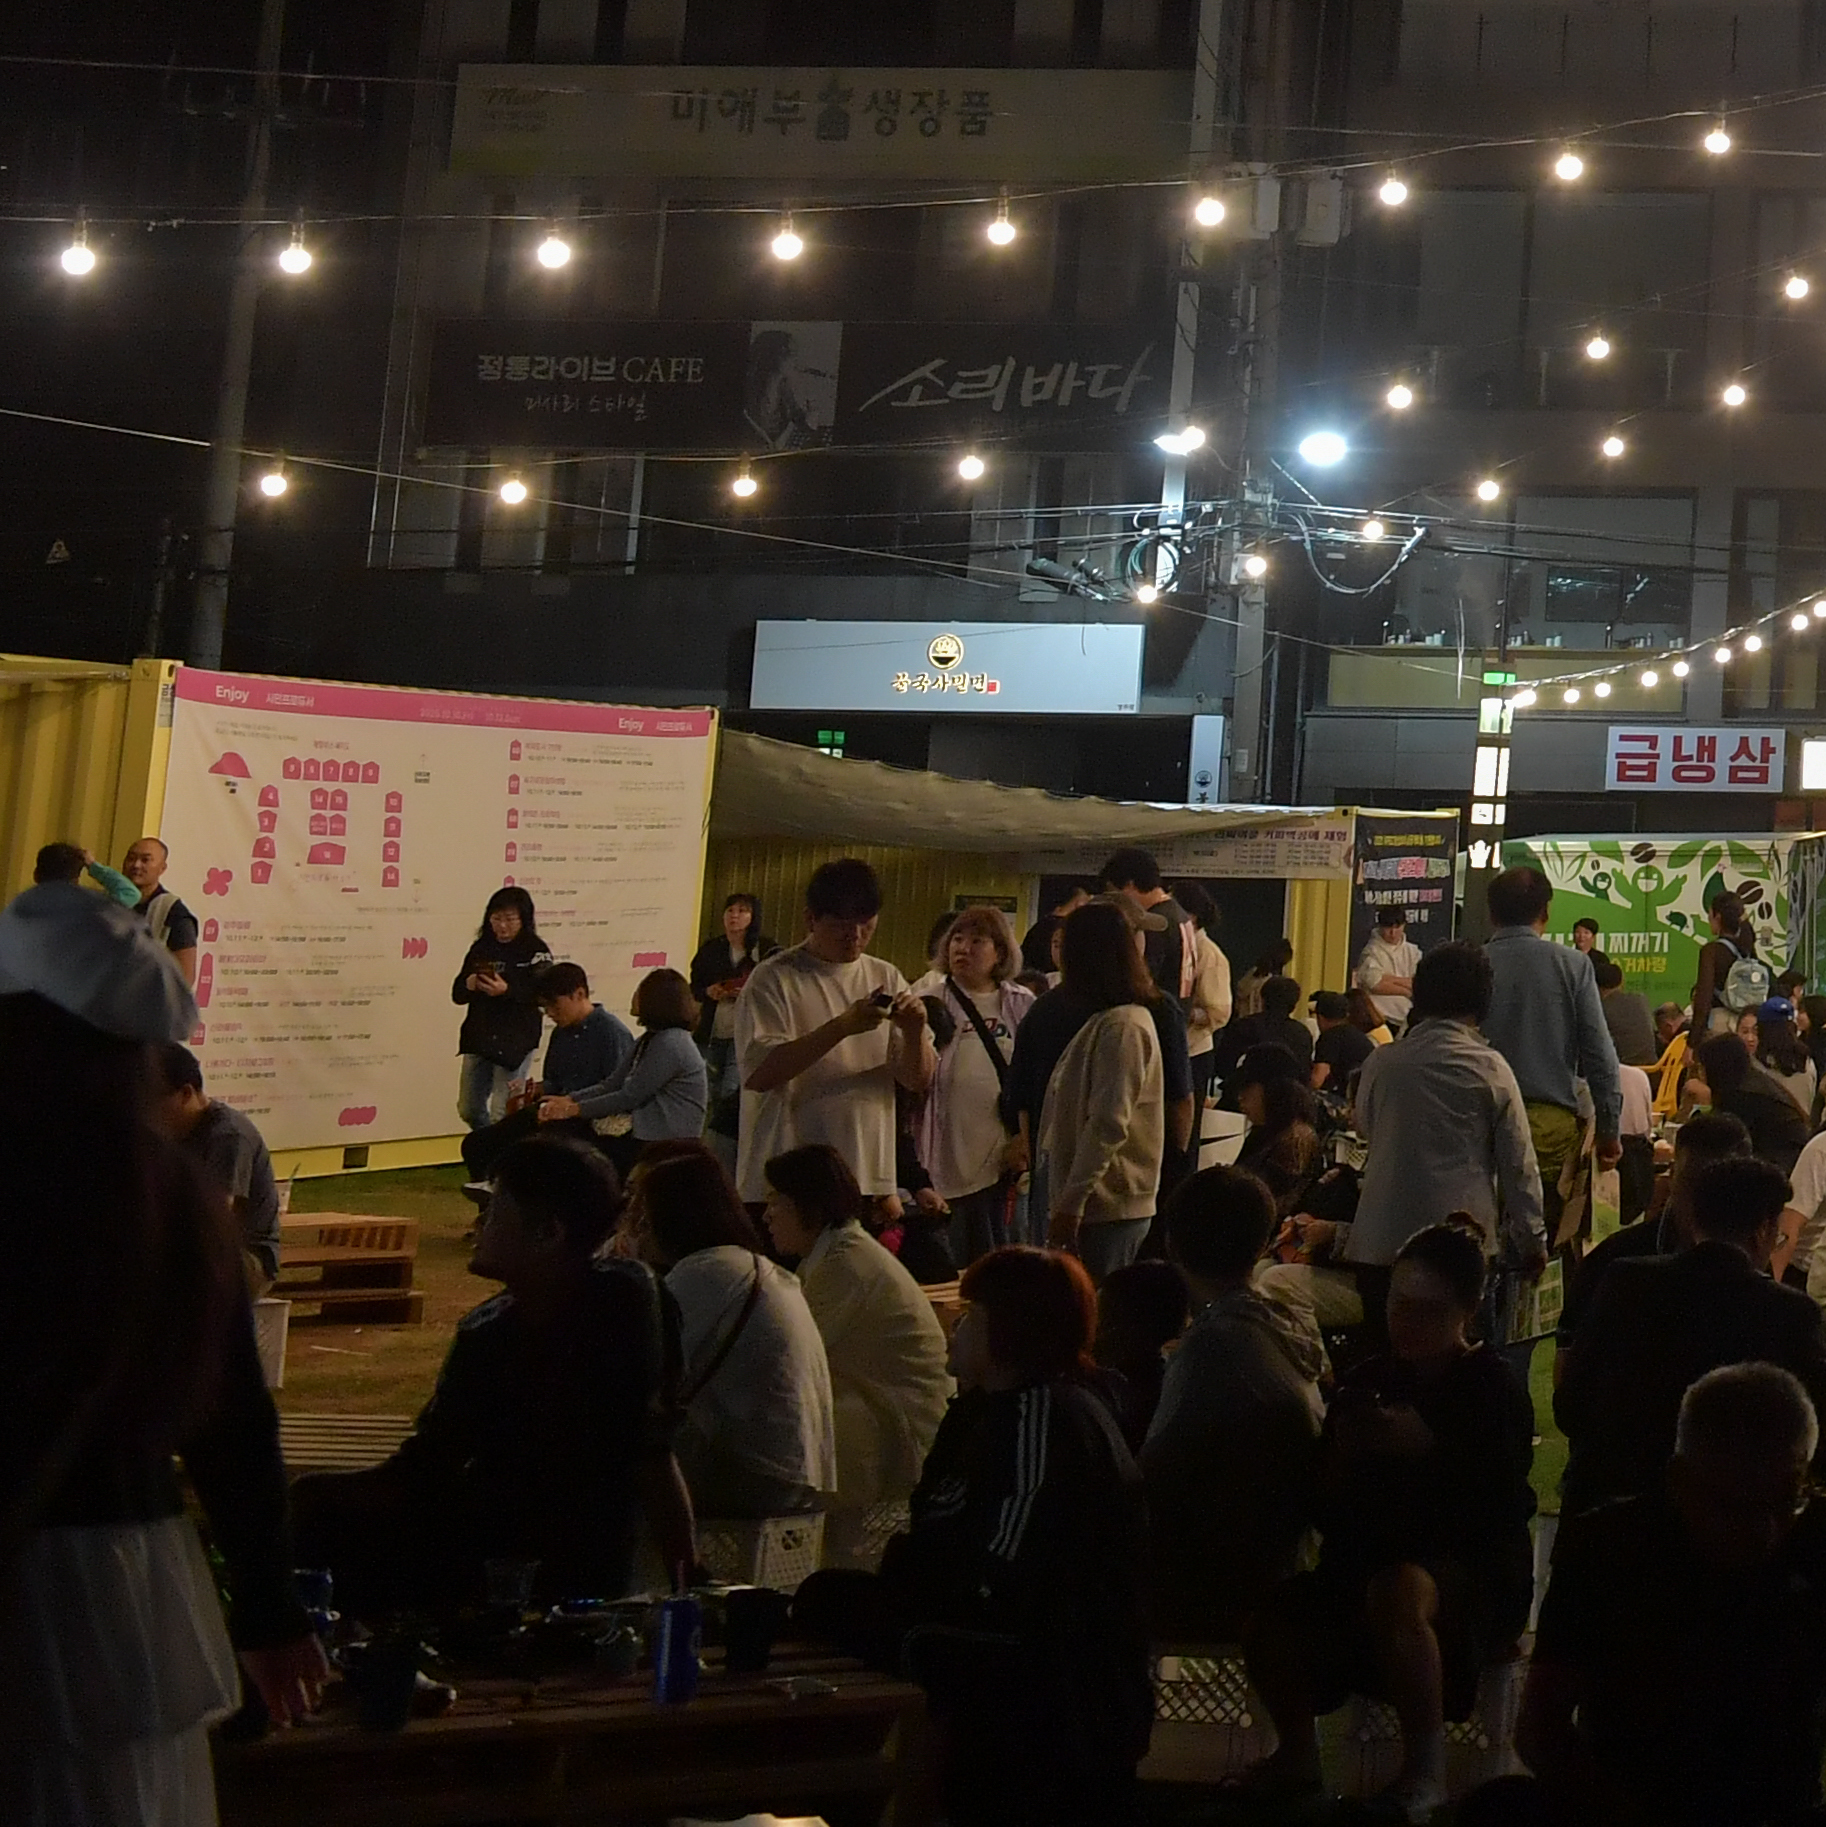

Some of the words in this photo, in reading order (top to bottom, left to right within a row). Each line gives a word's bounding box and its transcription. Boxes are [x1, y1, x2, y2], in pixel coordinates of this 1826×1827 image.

[477, 354, 617, 383] 정통라이브
[621, 356, 705, 384] CAFE
[857, 346, 1155, 416] 소리바다
[215, 684, 250, 704] Enjoy
[618, 716, 644, 733] Enjoy
[1615, 733, 1777, 785] 급냉삼
[1608, 931, 1670, 954] 찌꺼기
